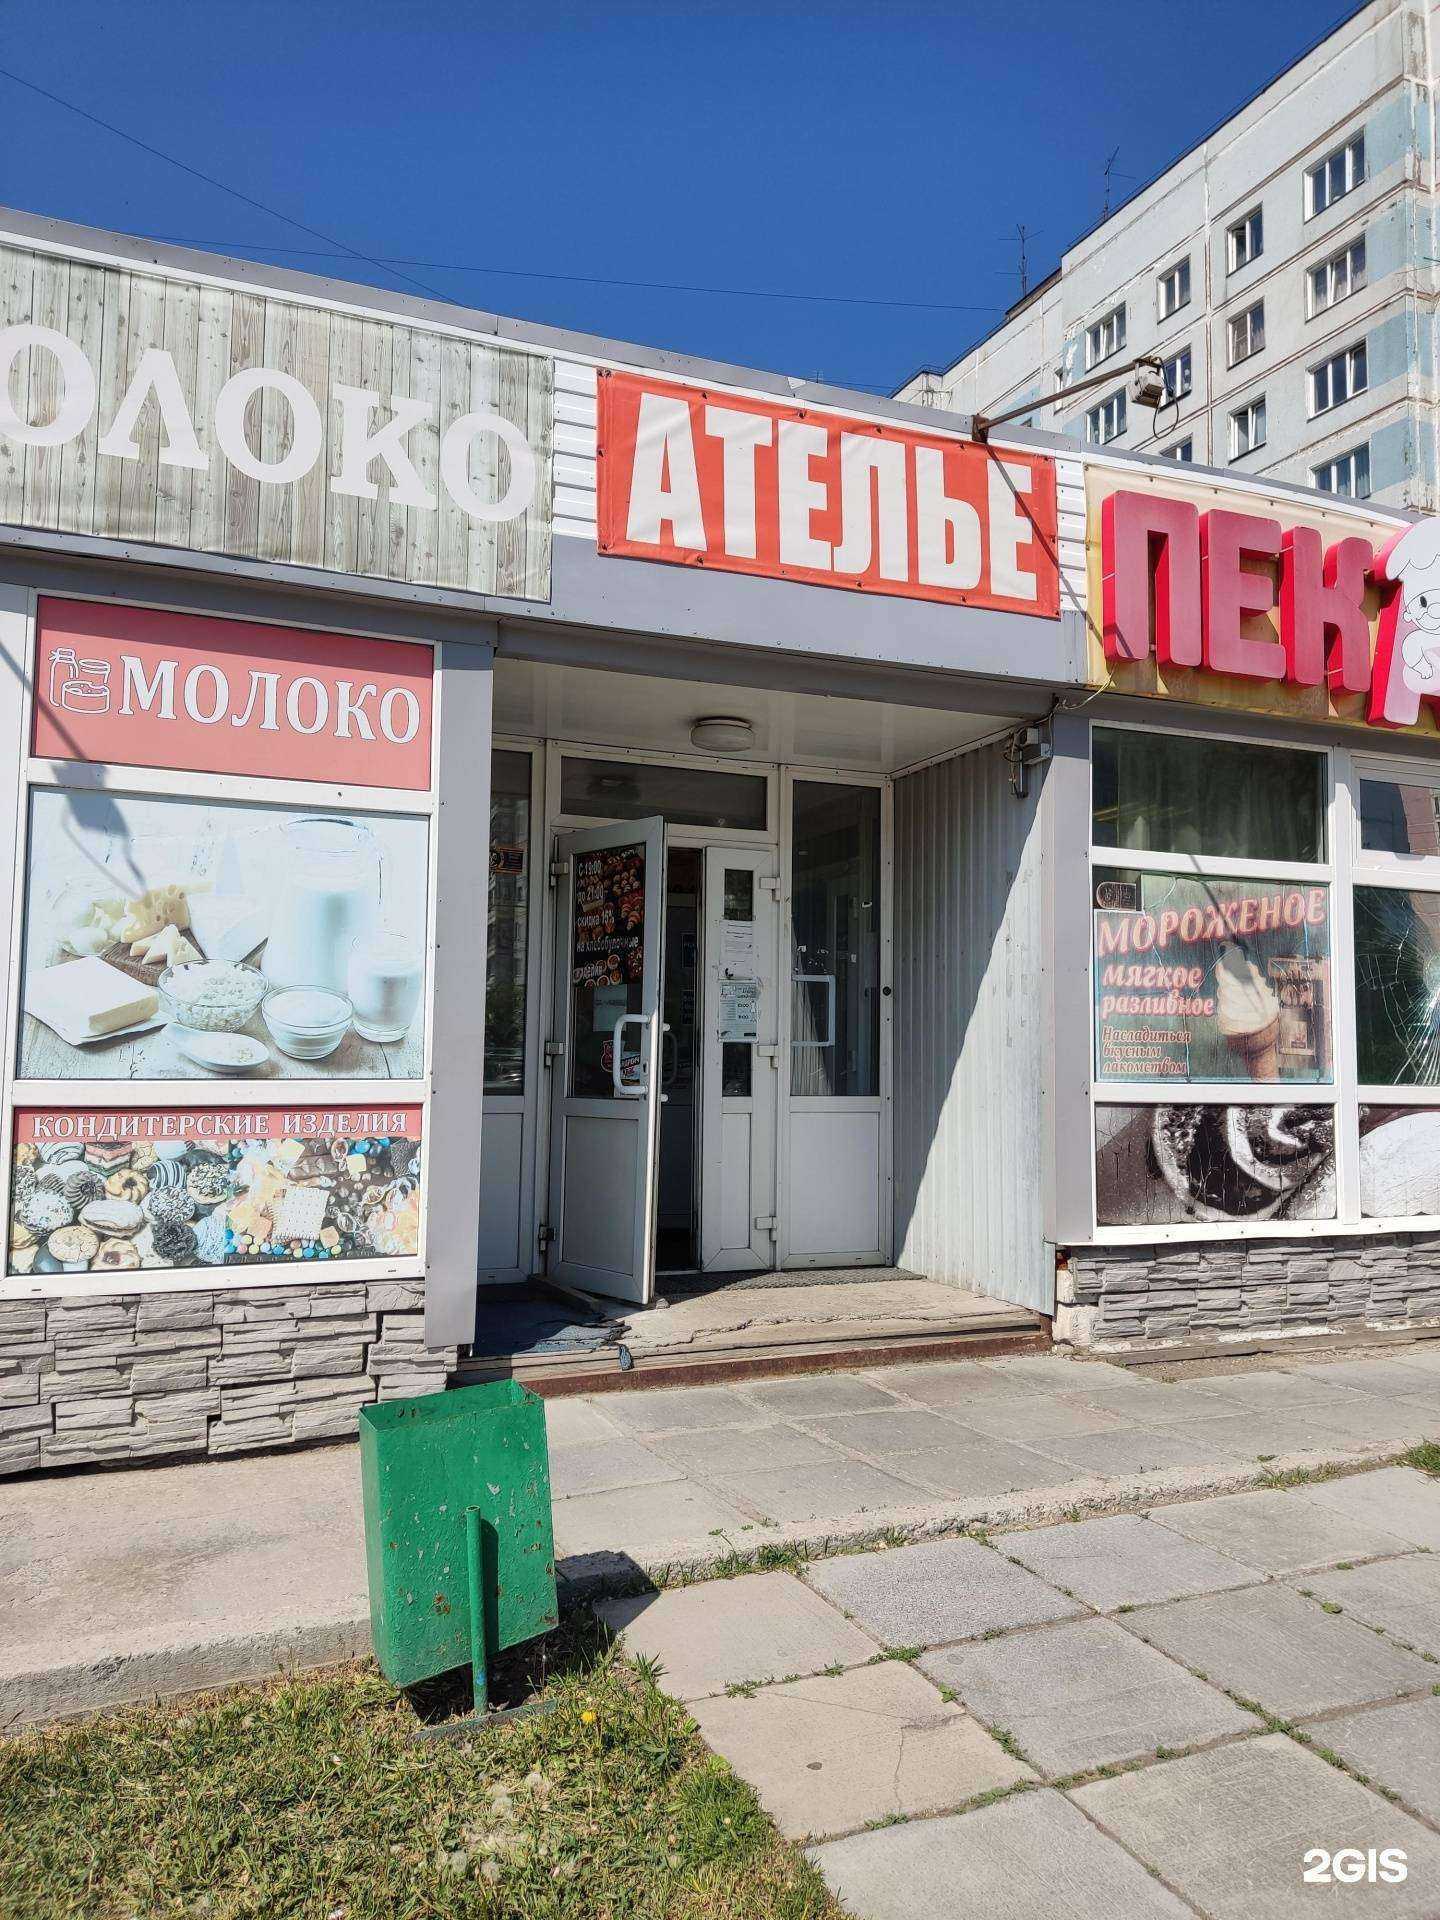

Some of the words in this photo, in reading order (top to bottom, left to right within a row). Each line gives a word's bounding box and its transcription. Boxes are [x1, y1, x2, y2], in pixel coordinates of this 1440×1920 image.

[626, 392, 1038, 602] АТЕЛЬЕ
[118, 654, 421, 745] МОЛОКО
[1097, 888, 1327, 956] МОРОЖЕНОЕ
[1102, 963, 1203, 990] мягкое
[1101, 989, 1216, 1019] разливное
[1102, 1024, 1192, 1043] Насладиться
[1103, 1042, 1162, 1061] вкусным
[1103, 1057, 1188, 1075] лакомством
[32, 1113, 270, 1140] КОНДИТЕРСКИЕ
[282, 1112, 408, 1138] ИЗДЕЛИЯ
